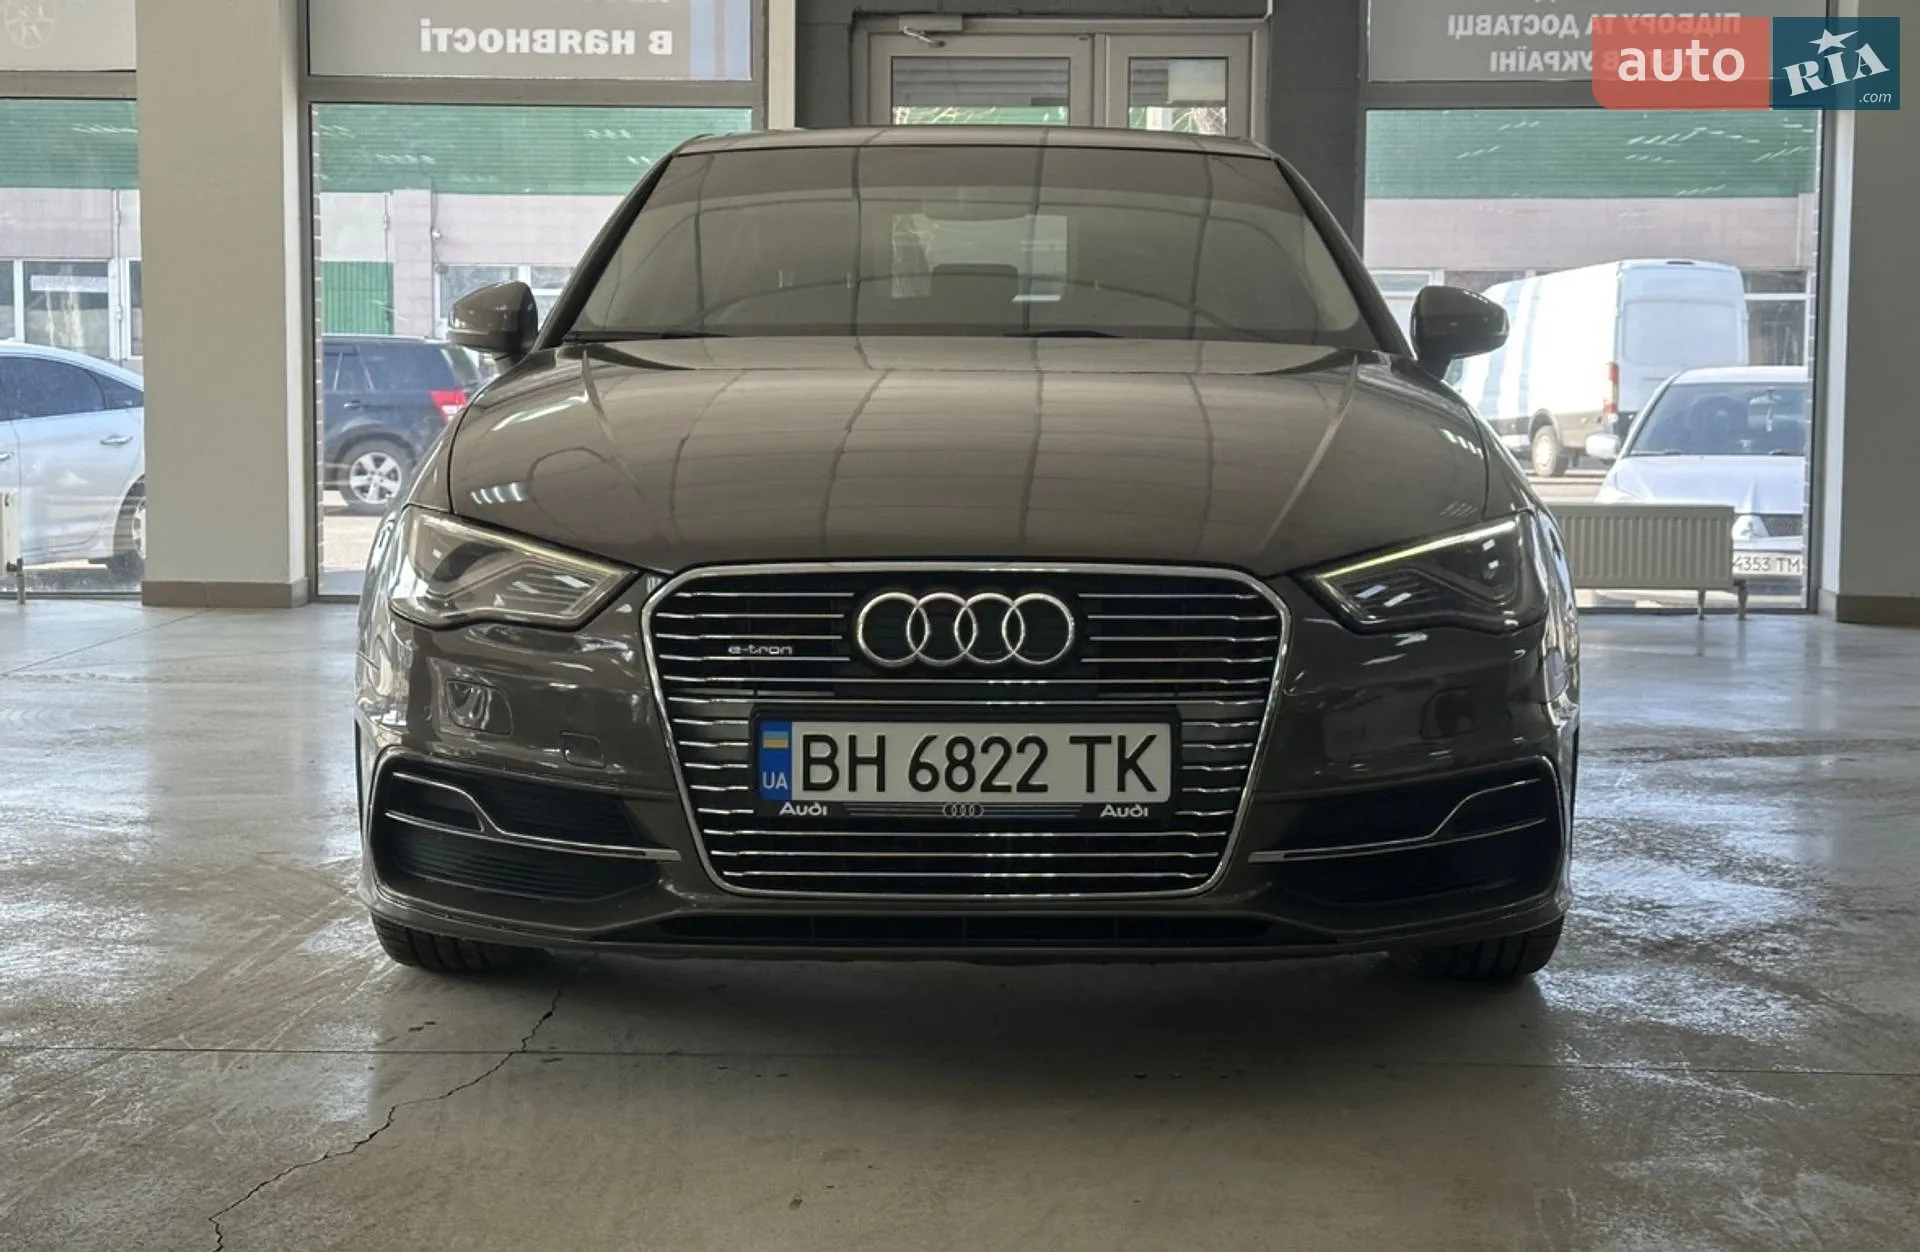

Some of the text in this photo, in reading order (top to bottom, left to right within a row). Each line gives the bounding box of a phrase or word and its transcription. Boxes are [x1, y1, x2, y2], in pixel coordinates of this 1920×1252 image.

[1776, 556, 1800, 572] TM
[727, 645, 793, 656] e-tron
[802, 734, 1158, 793] BH 6822 TK
[762, 771, 788, 790] UA
[779, 801, 828, 816] Audi
[1100, 802, 1149, 818] Audi
